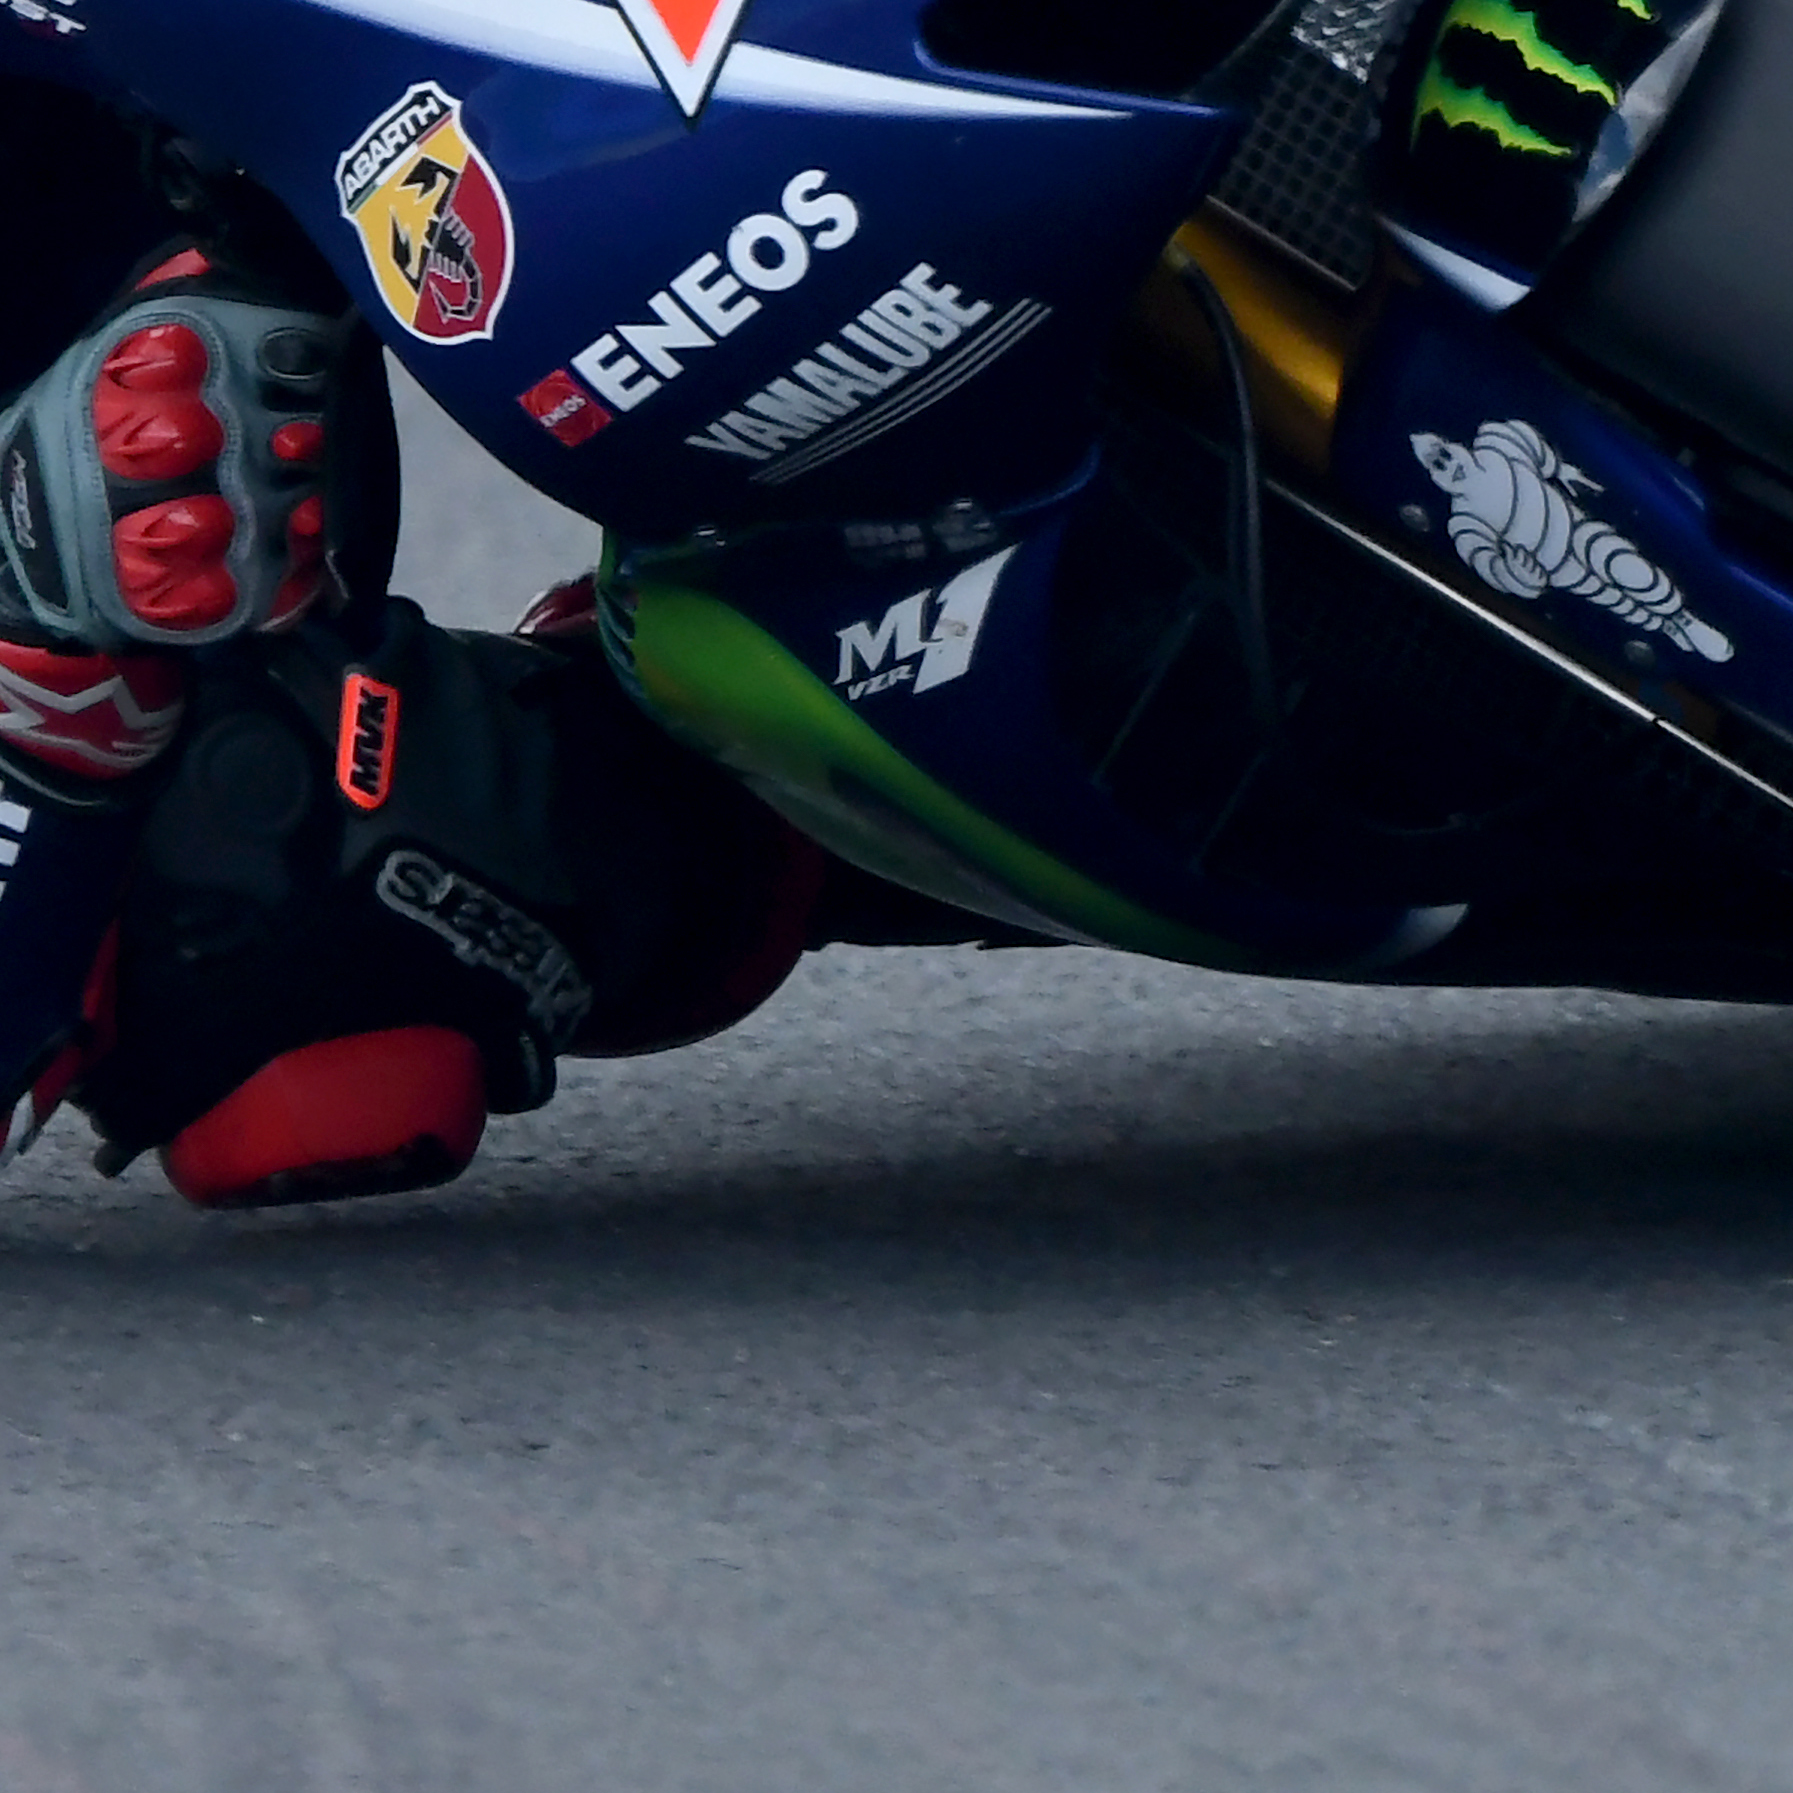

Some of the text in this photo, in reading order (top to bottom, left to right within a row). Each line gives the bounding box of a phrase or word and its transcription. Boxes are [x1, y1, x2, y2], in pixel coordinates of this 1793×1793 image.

[344, 97, 441, 200] ABARTH
[570, 168, 859, 412] ENEOS
[685, 263, 994, 461] YAMALUBE
[832, 541, 1023, 694] M1
[349, 687, 387, 795] MVK
